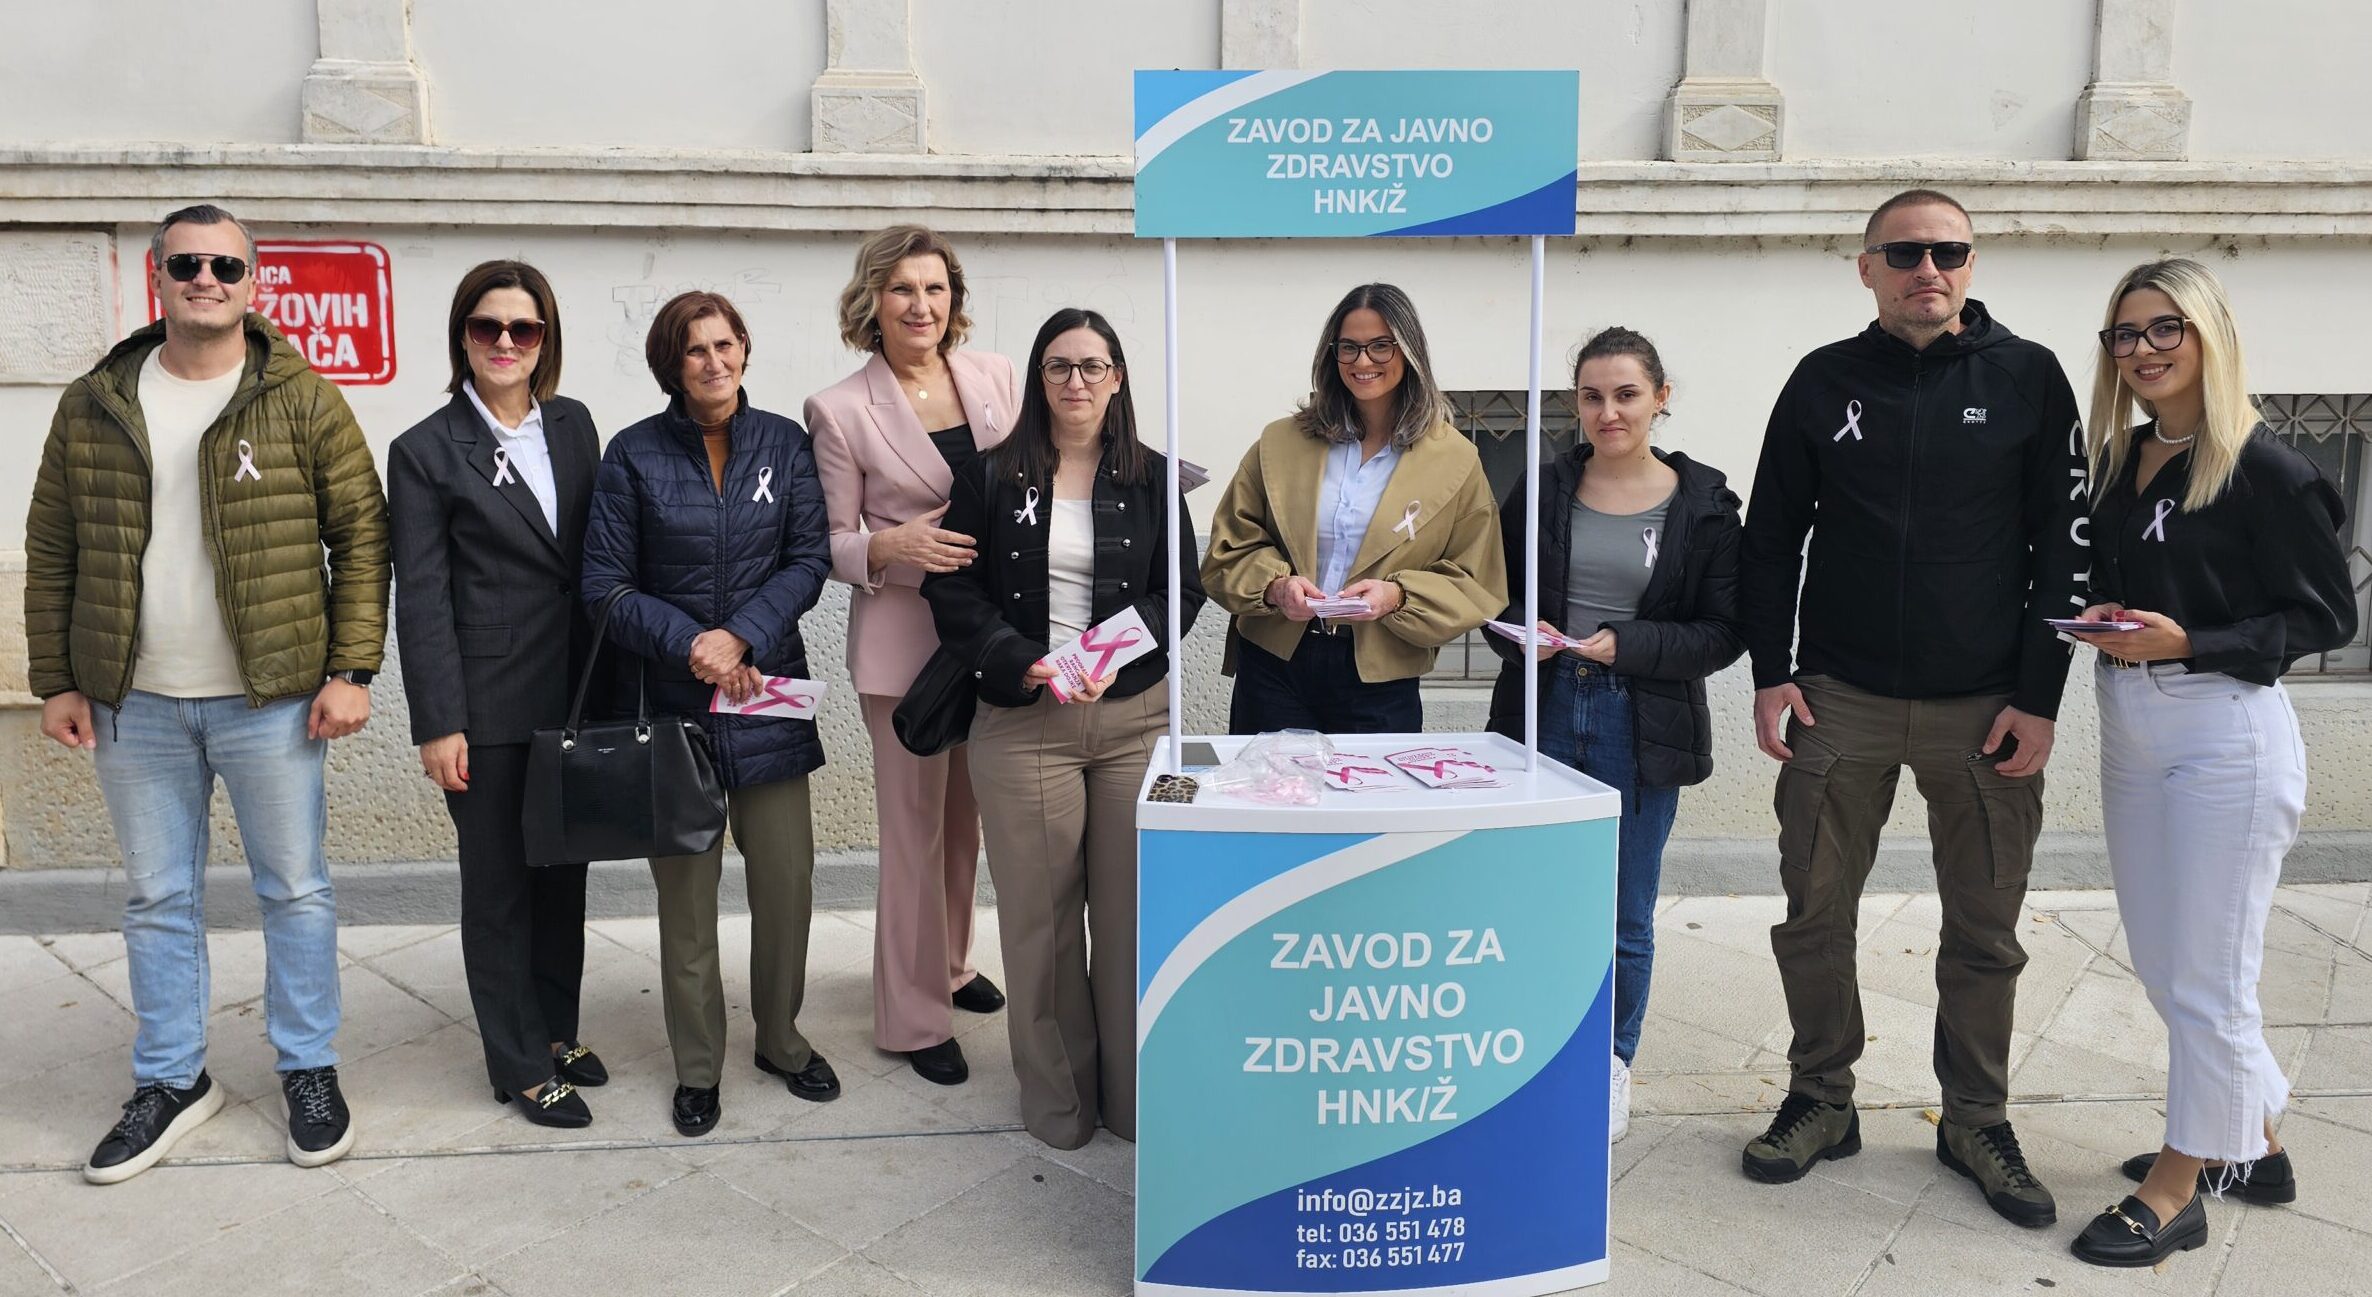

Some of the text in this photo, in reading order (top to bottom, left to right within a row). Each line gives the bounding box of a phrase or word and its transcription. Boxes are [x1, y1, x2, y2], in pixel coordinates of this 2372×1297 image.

[1227, 118, 1494, 144] ZAVOD ZA JAVNO
[1266, 153, 1454, 180] ZDRAVSTVO
[1314, 184, 1407, 214] HNK/Ž
[256, 265, 292, 285] ICA
[247, 286, 369, 329] ŽOVIH
[1270, 928, 1506, 969] ZAVOD ZA
[1309, 982, 1467, 1022] JAVNO
[1242, 1028, 1525, 1073] ZDRAVSTVO
[1317, 1076, 1458, 1125] HNK/Ž
[1297, 1184, 1462, 1216] info@zzjz.ba
[1296, 1217, 1466, 1243] tel: 036 551 478
[1296, 1242, 1466, 1269] fax: 036 551 477
